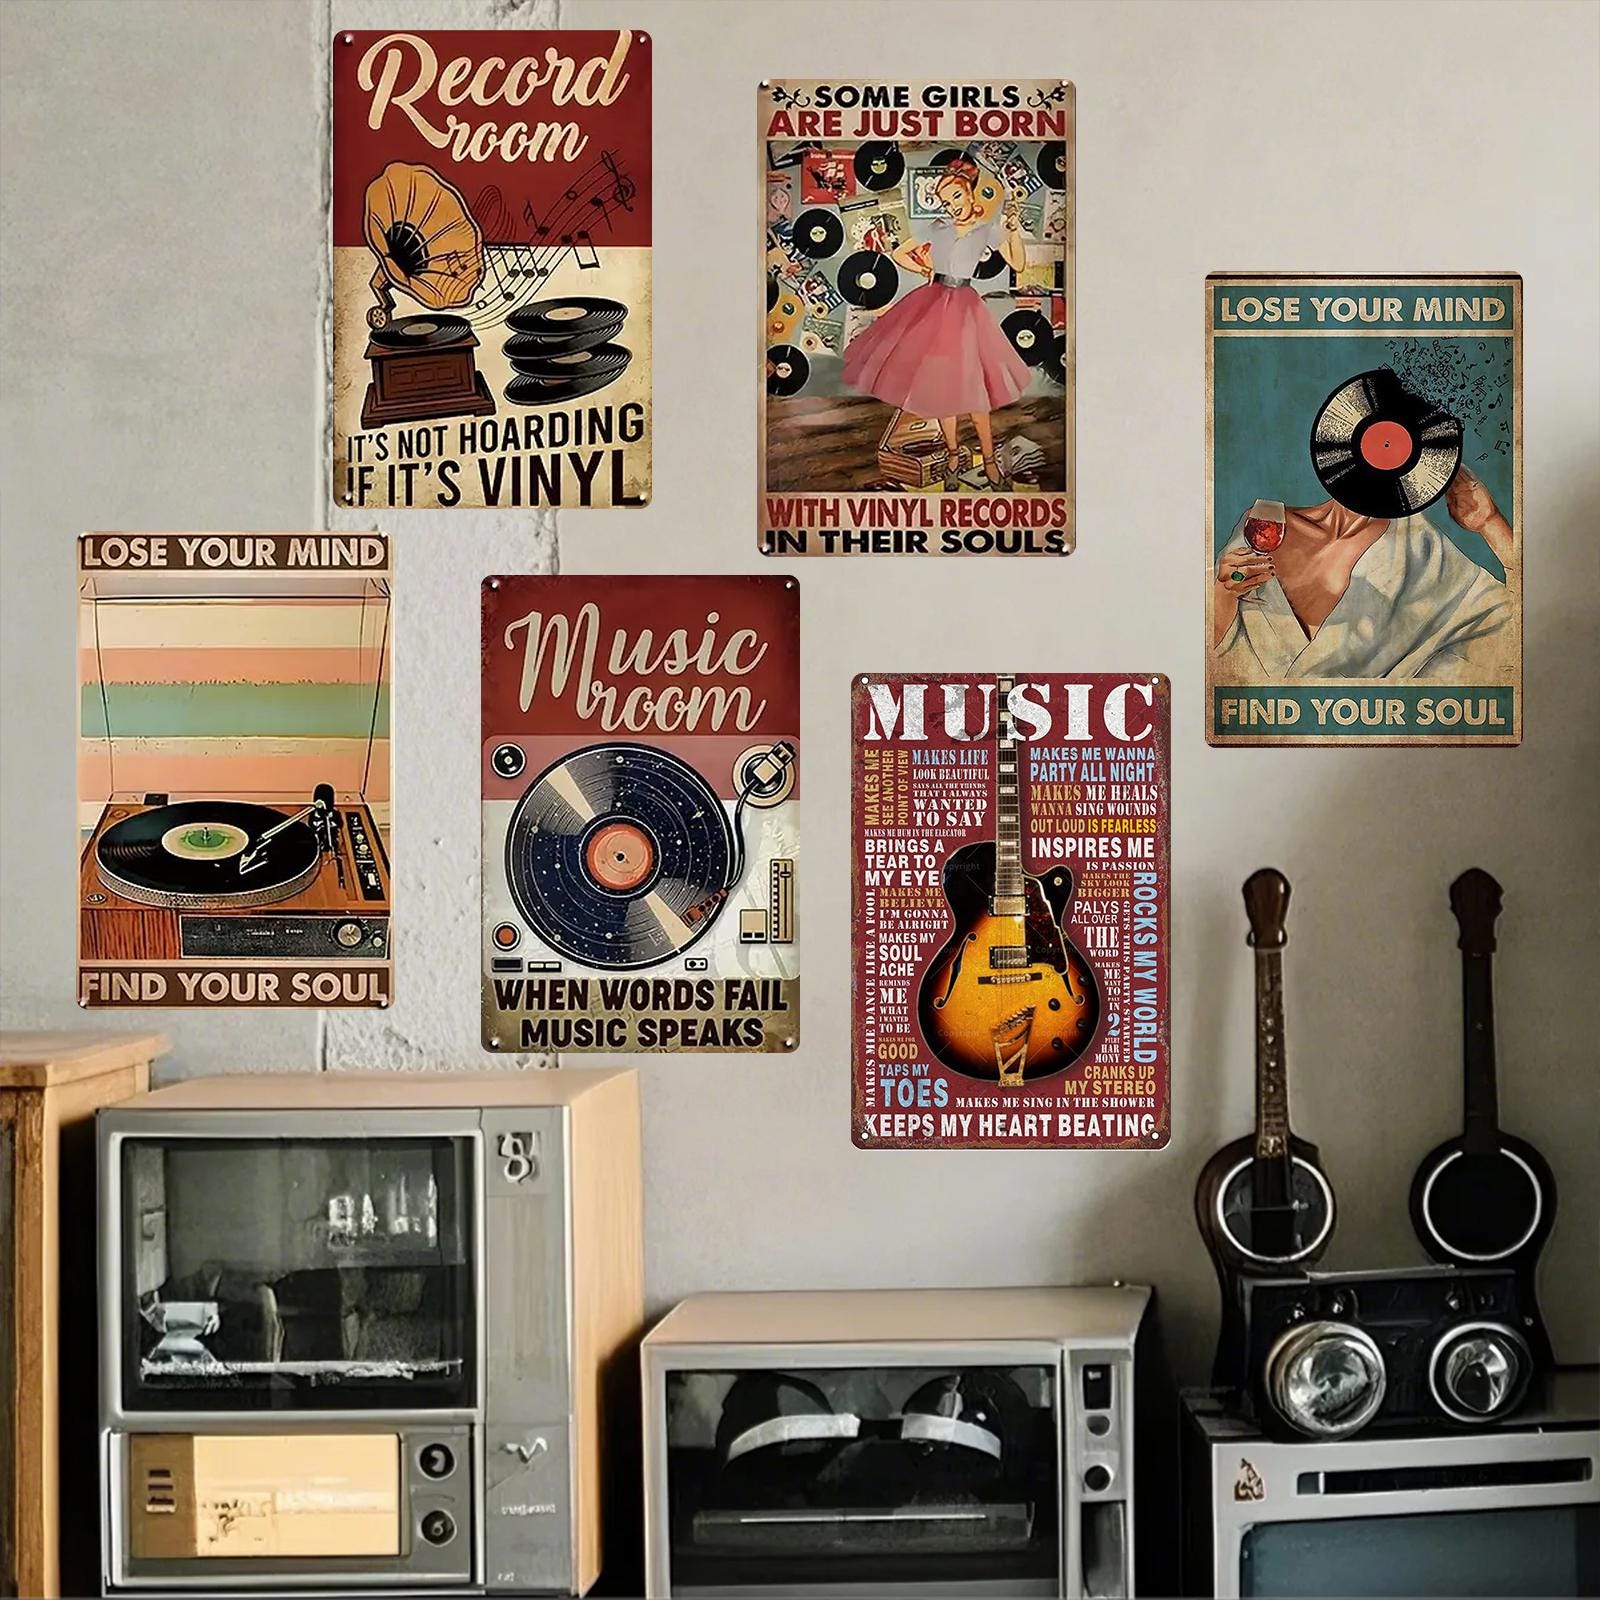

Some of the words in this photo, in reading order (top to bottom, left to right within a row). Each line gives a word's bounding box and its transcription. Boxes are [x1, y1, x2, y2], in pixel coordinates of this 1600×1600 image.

[358, 30, 632, 149] Record
[814, 85, 909, 108] SOME
[923, 85, 1019, 108] GIRLS
[767, 110, 842, 137] ARE
[853, 110, 944, 137] JUST
[956, 110, 1065, 137] BORN
[446, 115, 589, 162] room
[1221, 297, 1300, 323] LOSE
[1310, 297, 1403, 323] YOUR
[1414, 297, 1505, 323] MIND
[347, 431, 390, 463] IT'S
[401, 424, 448, 459] NOT
[461, 402, 644, 454] HOARDING
[347, 466, 374, 507] IF
[388, 461, 461, 507] IT'S
[478, 450, 642, 507] VINYL
[767, 499, 840, 527] WITH
[847, 499, 933, 527] VINYL
[940, 499, 1066, 527] RECORDS
[764, 530, 810, 554] IN
[819, 530, 931, 554] THEIR
[940, 530, 1064, 554] SOULS
[84, 537, 168, 567] LOSE
[179, 537, 276, 567] YOUR
[287, 537, 385, 567] MIND
[504, 602, 768, 719] Music
[590, 680, 767, 732] room
[863, 683, 1153, 742] MUSIC
[1221, 698, 1300, 725] FIND
[1310, 698, 1405, 725] YOUR
[1416, 698, 1505, 725] SOUL
[865, 749, 879, 770] ME
[912, 750, 956, 765] MAKES
[960, 750, 989, 765] LIFE
[1030, 748, 1078, 760] MAKES
[1082, 748, 1101, 760] ME
[1105, 748, 1155, 760] WANNA
[898, 750, 908, 776] VIEW
[882, 750, 894, 802] ANOTHER
[913, 769, 937, 780] LOOK
[939, 769, 989, 780] BEAUTIFUL
[1030, 763, 1077, 782] PARTY
[1080, 763, 1106, 782] ALL
[1110, 763, 1155, 782] NIGHT
[898, 778, 908, 792] OF
[1031, 785, 1081, 800] MAKES
[1086, 785, 1106, 800] ME
[1111, 785, 1158, 800] HEALS
[865, 774, 879, 825] MAKES
[913, 799, 987, 810] WANTED
[882, 805, 894, 825] SEE
[898, 795, 908, 825] POINT
[1031, 803, 1072, 816] WANNA
[1075, 803, 1104, 816] SING
[1107, 803, 1157, 816] WOUNDS
[913, 811, 940, 826] TO
[946, 811, 986, 826] SAY
[1031, 819, 1053, 833] OUT
[1055, 819, 1085, 833] LOUD
[1088, 819, 1098, 833] IS
[1101, 819, 1157, 833] FEARLESS
[865, 839, 929, 853] BRINGS
[934, 839, 945, 853] A
[1031, 837, 1122, 858] INSPIRES
[1127, 837, 1155, 858] ME
[865, 854, 909, 869] TEAR
[914, 854, 936, 869] TO
[1086, 862, 1098, 870] IS
[1102, 862, 1155, 870] PASSION
[865, 870, 894, 886] MY
[880, 887, 921, 897] MAKES
[925, 887, 942, 897] ME
[1078, 888, 1130, 898] BIGGER
[866, 889, 876, 924] FOOL
[880, 898, 945, 908] BELIEVE
[1074, 901, 1119, 914] PALYS
[1133, 872, 1157, 945] ROCKS
[904, 909, 948, 919] GONNA
[1071, 915, 1089, 924] ALL
[1091, 915, 1118, 924] OVER
[866, 929, 876, 937] A
[880, 920, 894, 929] BE
[897, 920, 948, 929] ALRIGHT
[879, 933, 917, 943] MAKES
[920, 933, 936, 943] MY
[1084, 926, 1120, 948] THE
[866, 941, 876, 974] LIKE
[879, 944, 923, 962] SOUL
[1090, 949, 1118, 957] WORD
[879, 963, 915, 976] ACHE
[1104, 969, 1120, 979] ME
[1133, 951, 1157, 982] MY
[81, 972, 167, 1001] FIND
[178, 972, 279, 1001] YOUR
[291, 972, 387, 1001] SOUL
[493, 979, 589, 1011] WHEN
[600, 979, 714, 1011] WORDS
[724, 979, 788, 1011] FAIL
[1106, 987, 1120, 996] TO
[866, 979, 876, 1025] DANCE
[879, 988, 907, 1004] ME
[880, 1006, 908, 1015] WHAT
[1109, 1002, 1120, 1010] IN
[520, 1017, 627, 1048] MUSIC
[636, 1017, 764, 1048] SPEAKS
[879, 1024, 893, 1033] TO
[896, 1024, 911, 1033] BE
[1107, 1012, 1120, 1036] 2
[1133, 988, 1157, 1063] WORLD
[878, 1043, 919, 1059] GOOD
[1101, 1044, 1119, 1053] HAR
[1095, 1054, 1120, 1063] MONY
[879, 1064, 909, 1076] TAPS
[912, 1064, 929, 1076] MY
[1084, 1066, 1135, 1079] CRANKS
[1138, 1066, 1155, 1079] UP
[866, 1059, 876, 1107] MAKES
[1064, 1080, 1090, 1095] MY
[1092, 1080, 1157, 1095] STEREO
[880, 1078, 949, 1108] TOES
[956, 1097, 999, 1108] MAKES
[1002, 1097, 1020, 1108] ME
[1023, 1097, 1053, 1108] SING
[1056, 1097, 1070, 1108] IN
[1073, 1097, 1099, 1108] THE
[1102, 1097, 1156, 1108] SHOWER
[864, 1113, 935, 1137] KEEPS
[941, 1113, 973, 1137] MY
[979, 1113, 1052, 1137] HEART
[1058, 1113, 1155, 1137] BEATING
